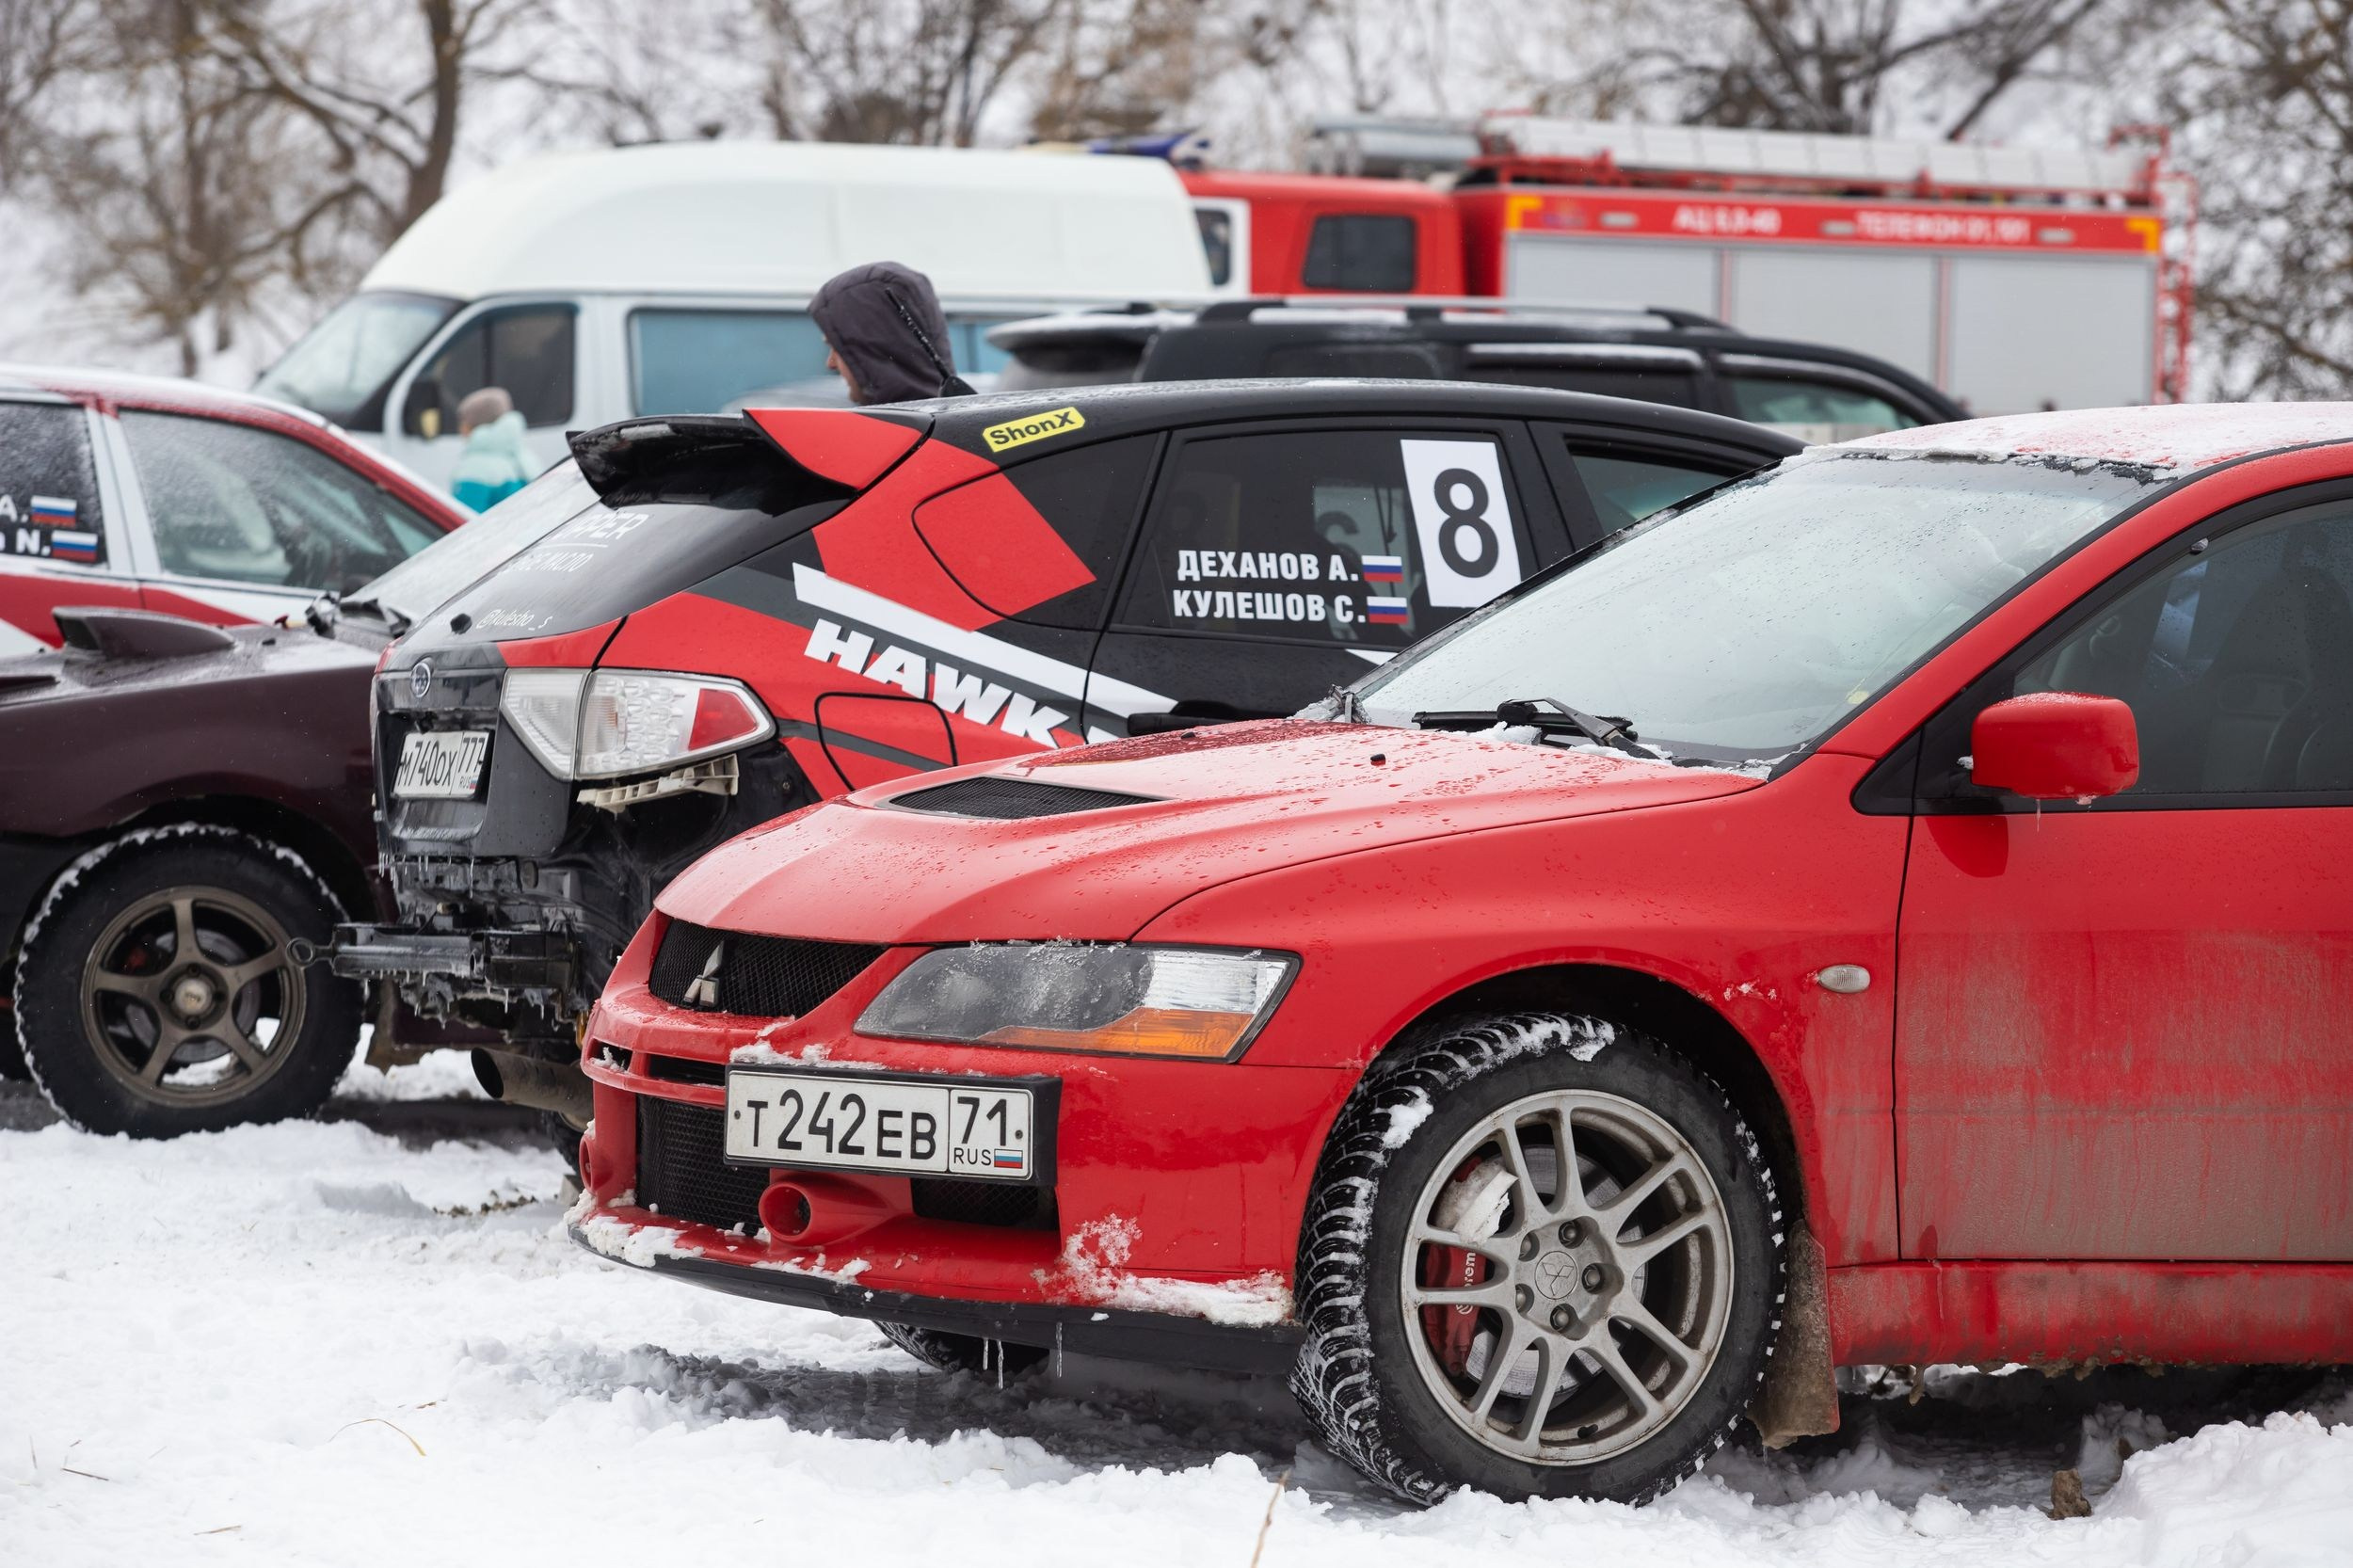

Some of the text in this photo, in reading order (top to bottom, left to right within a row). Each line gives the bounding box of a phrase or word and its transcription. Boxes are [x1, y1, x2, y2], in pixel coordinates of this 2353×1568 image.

[989, 411, 1075, 445] ShonX
[1433, 468, 1499, 578] 8
[1177, 550, 1359, 581] ДЕХАНОВ А.
[1173, 590, 1366, 623] КУЛЕШОВ С.
[803, 618, 1070, 749] HAWK
[458, 737, 486, 773] 777
[957, 1096, 1007, 1146] 71
[953, 1148, 991, 1166] RUS
